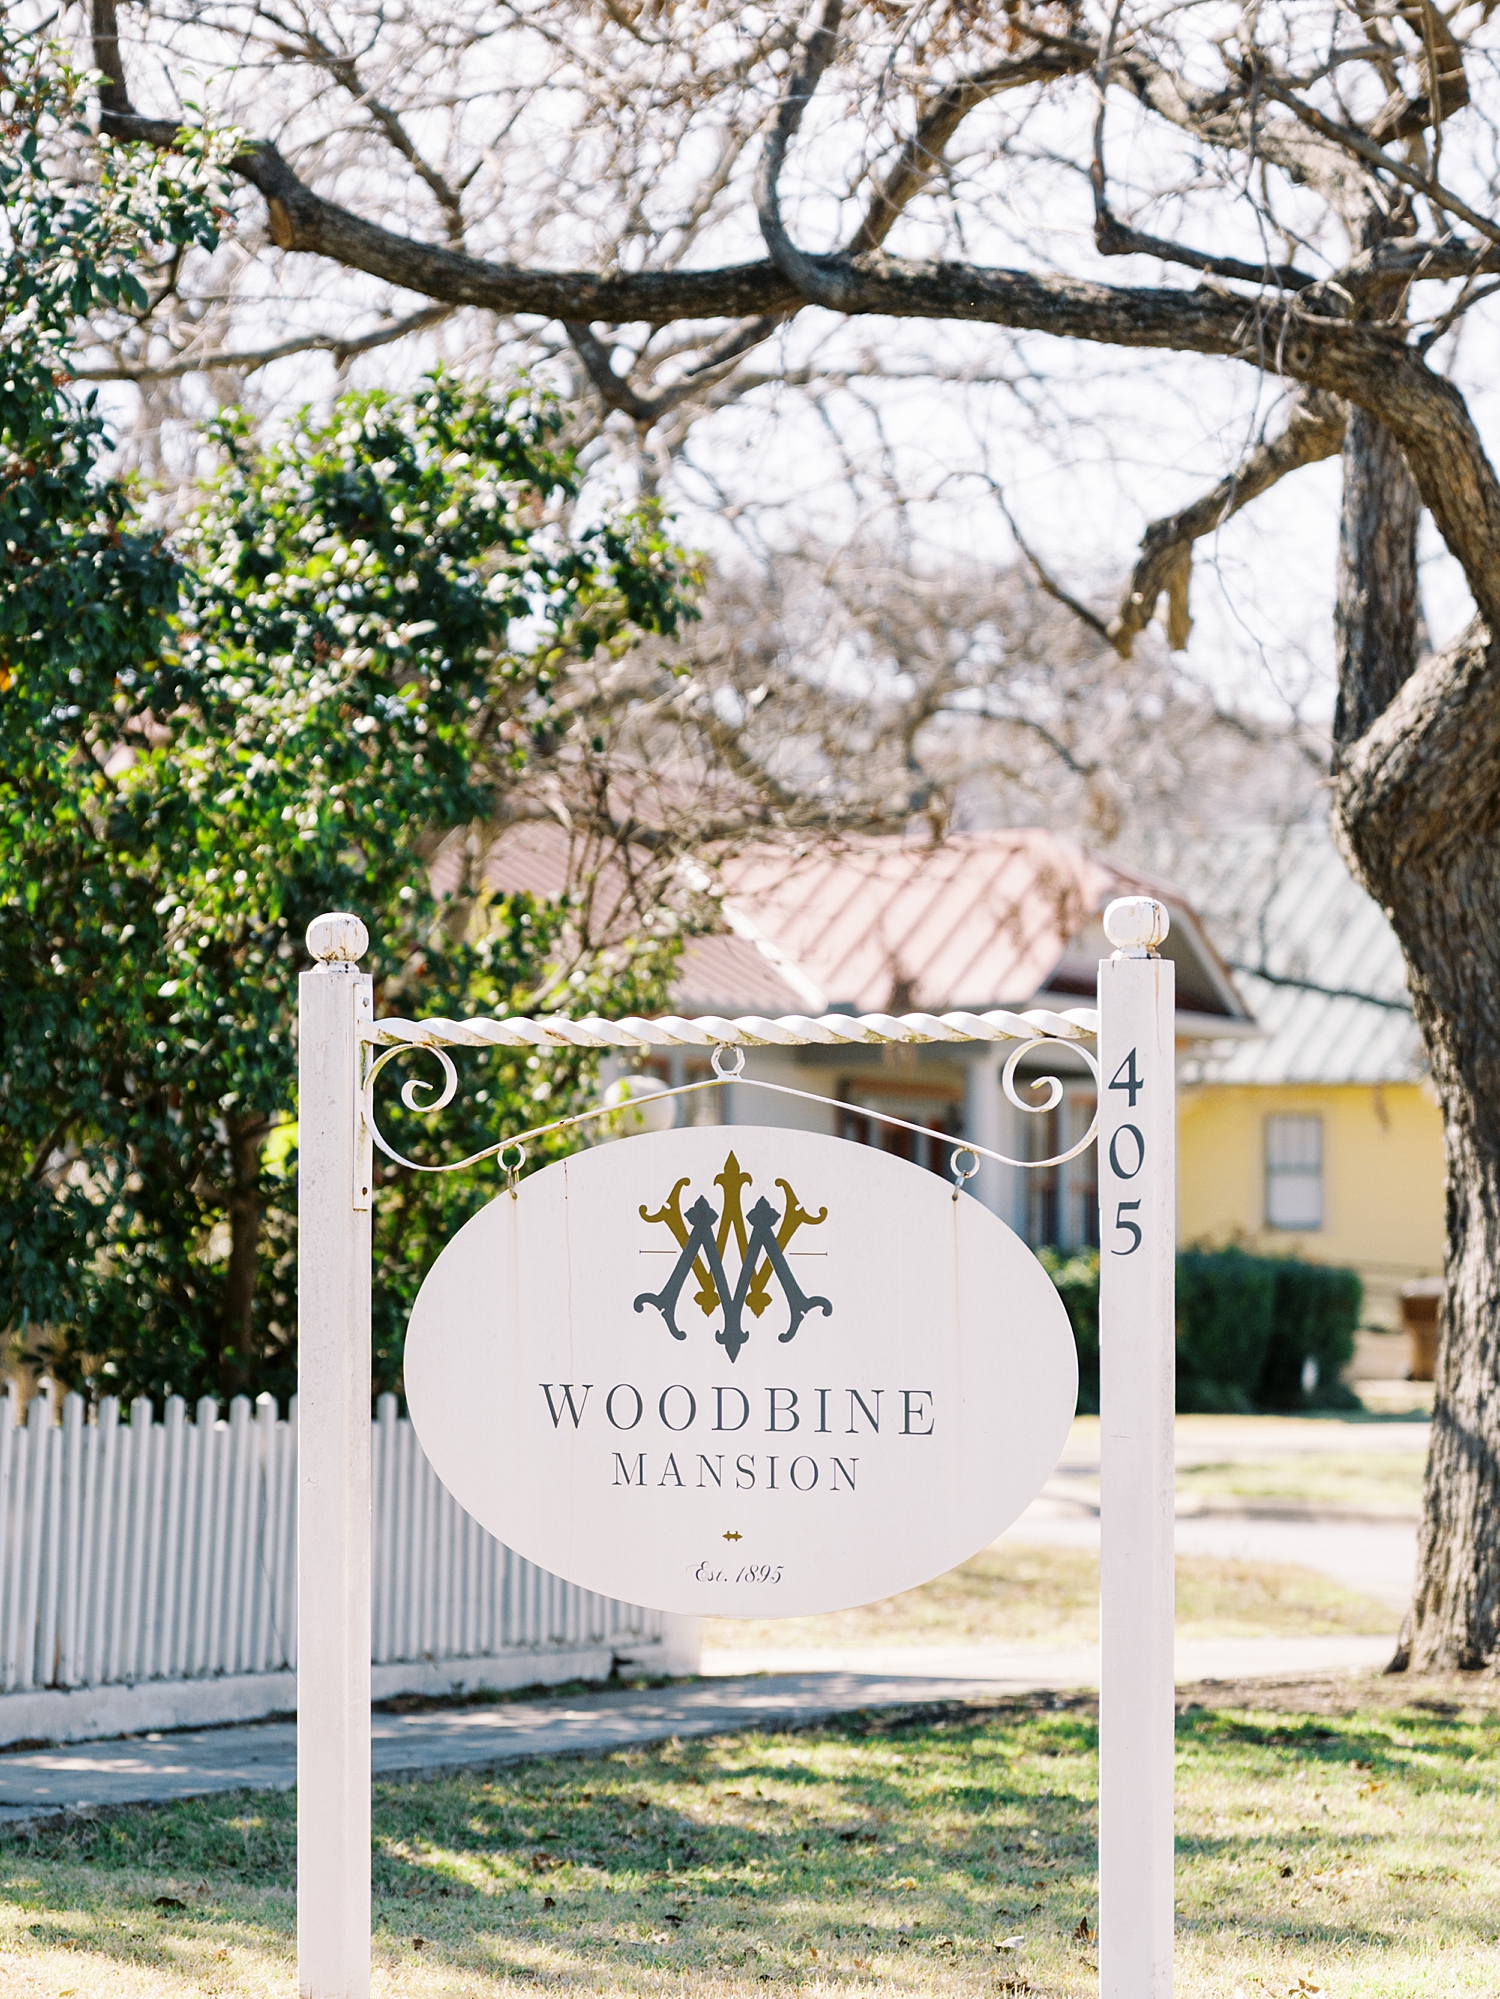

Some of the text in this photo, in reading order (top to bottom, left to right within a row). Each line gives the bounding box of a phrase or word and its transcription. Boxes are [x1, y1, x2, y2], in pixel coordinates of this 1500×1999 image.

[1108, 1046, 1145, 1256] 405
[538, 1383, 936, 1436] WOODBINE
[611, 1452, 860, 1492] MANSION
[686, 1560, 785, 1584] Est. 1895
